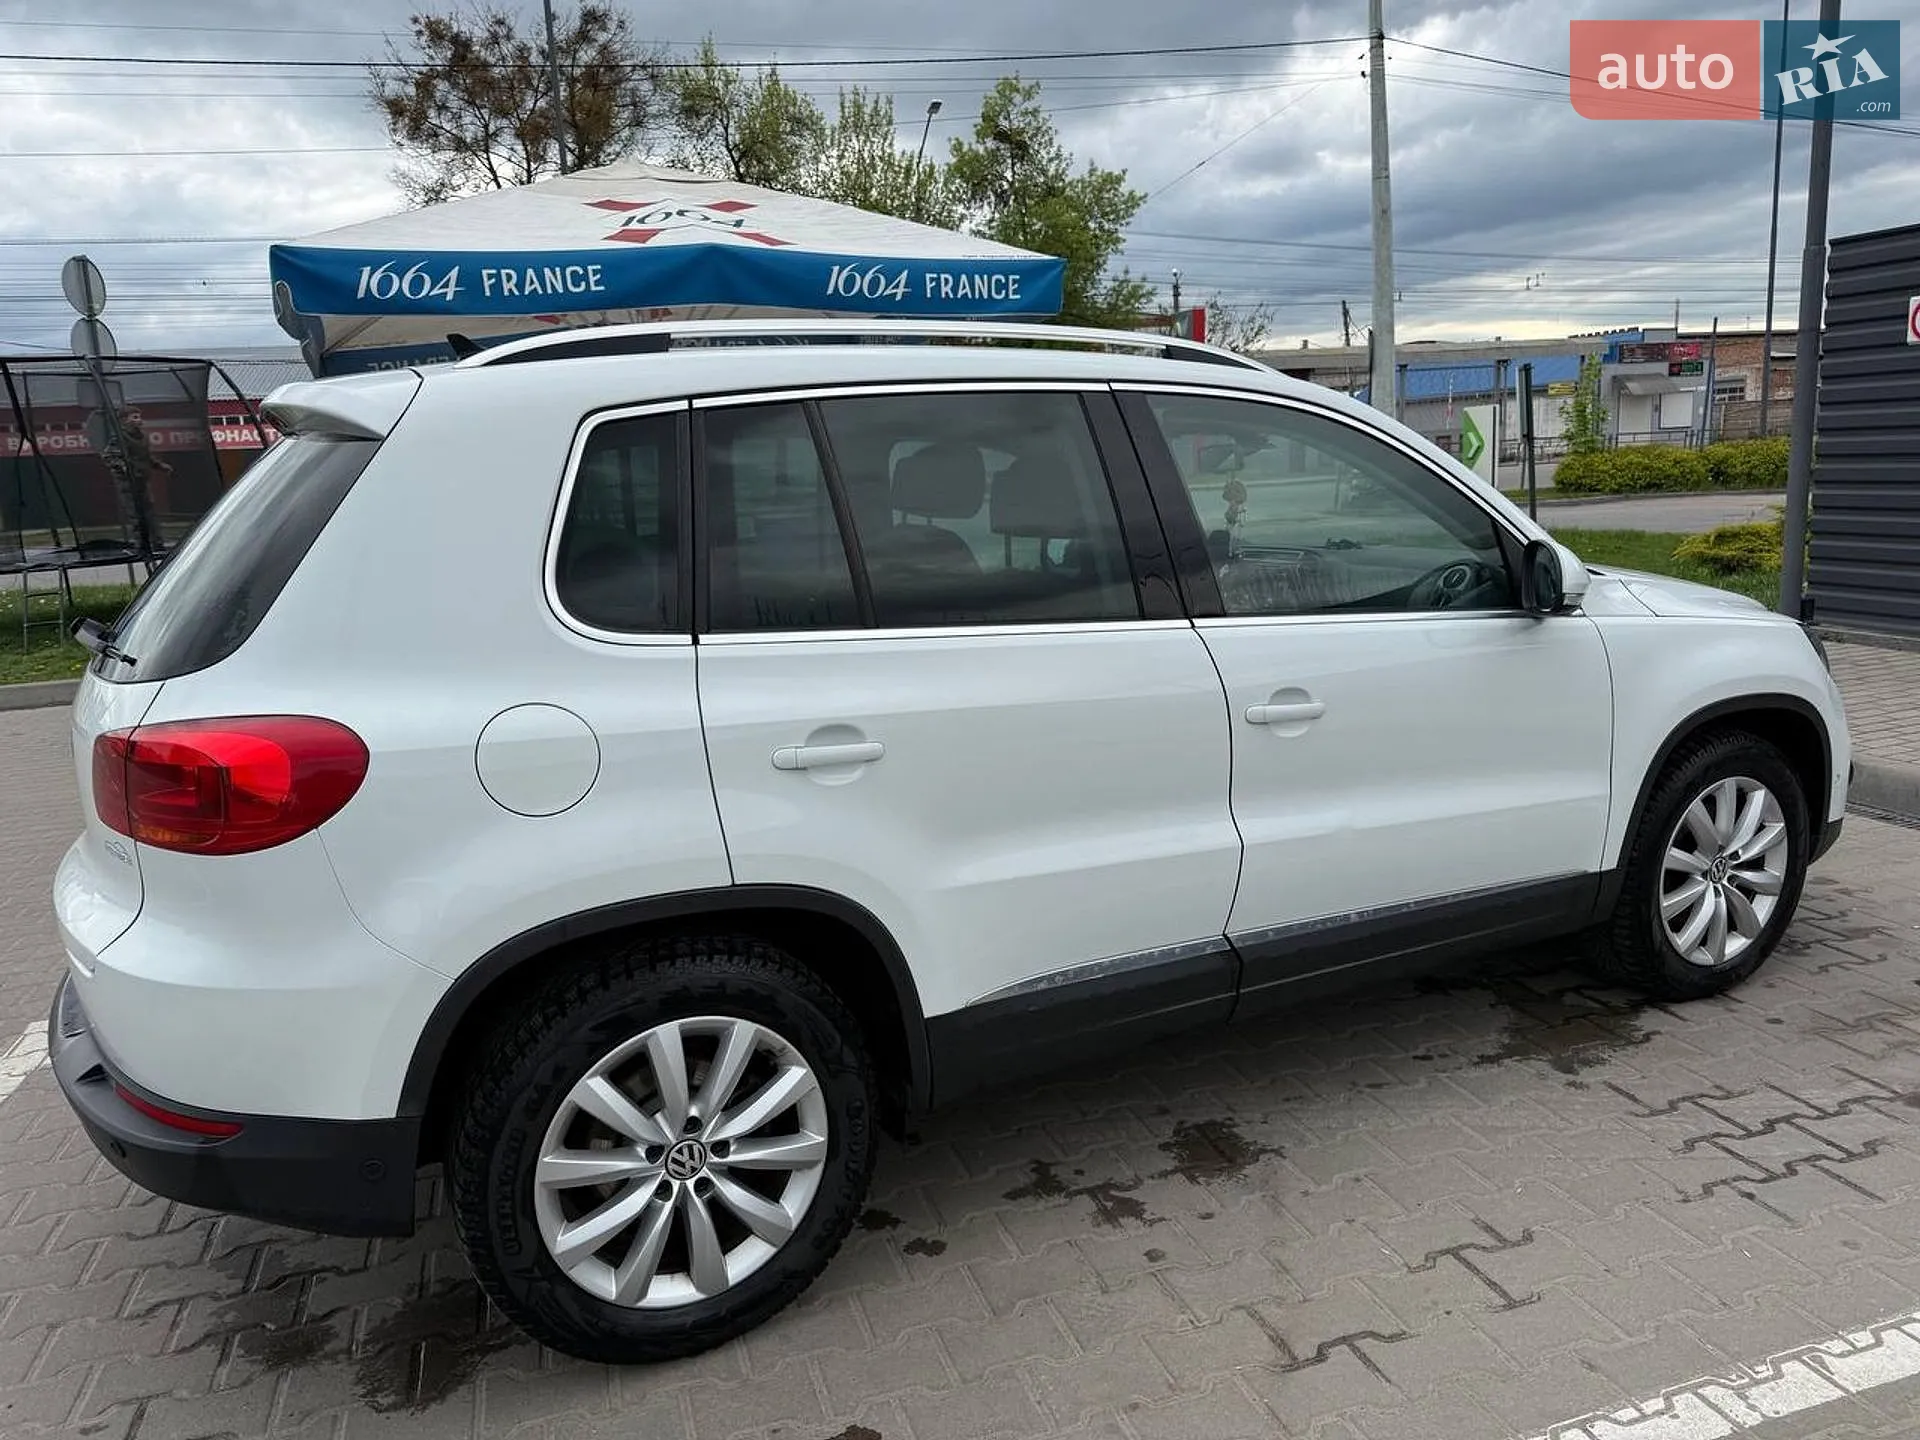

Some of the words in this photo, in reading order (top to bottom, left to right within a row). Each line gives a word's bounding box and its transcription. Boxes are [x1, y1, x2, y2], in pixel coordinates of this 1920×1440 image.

[356, 260, 467, 301] 1664
[481, 264, 606, 297] FRANCE
[826, 262, 913, 301] 1664
[925, 272, 1022, 300] FRANCE
